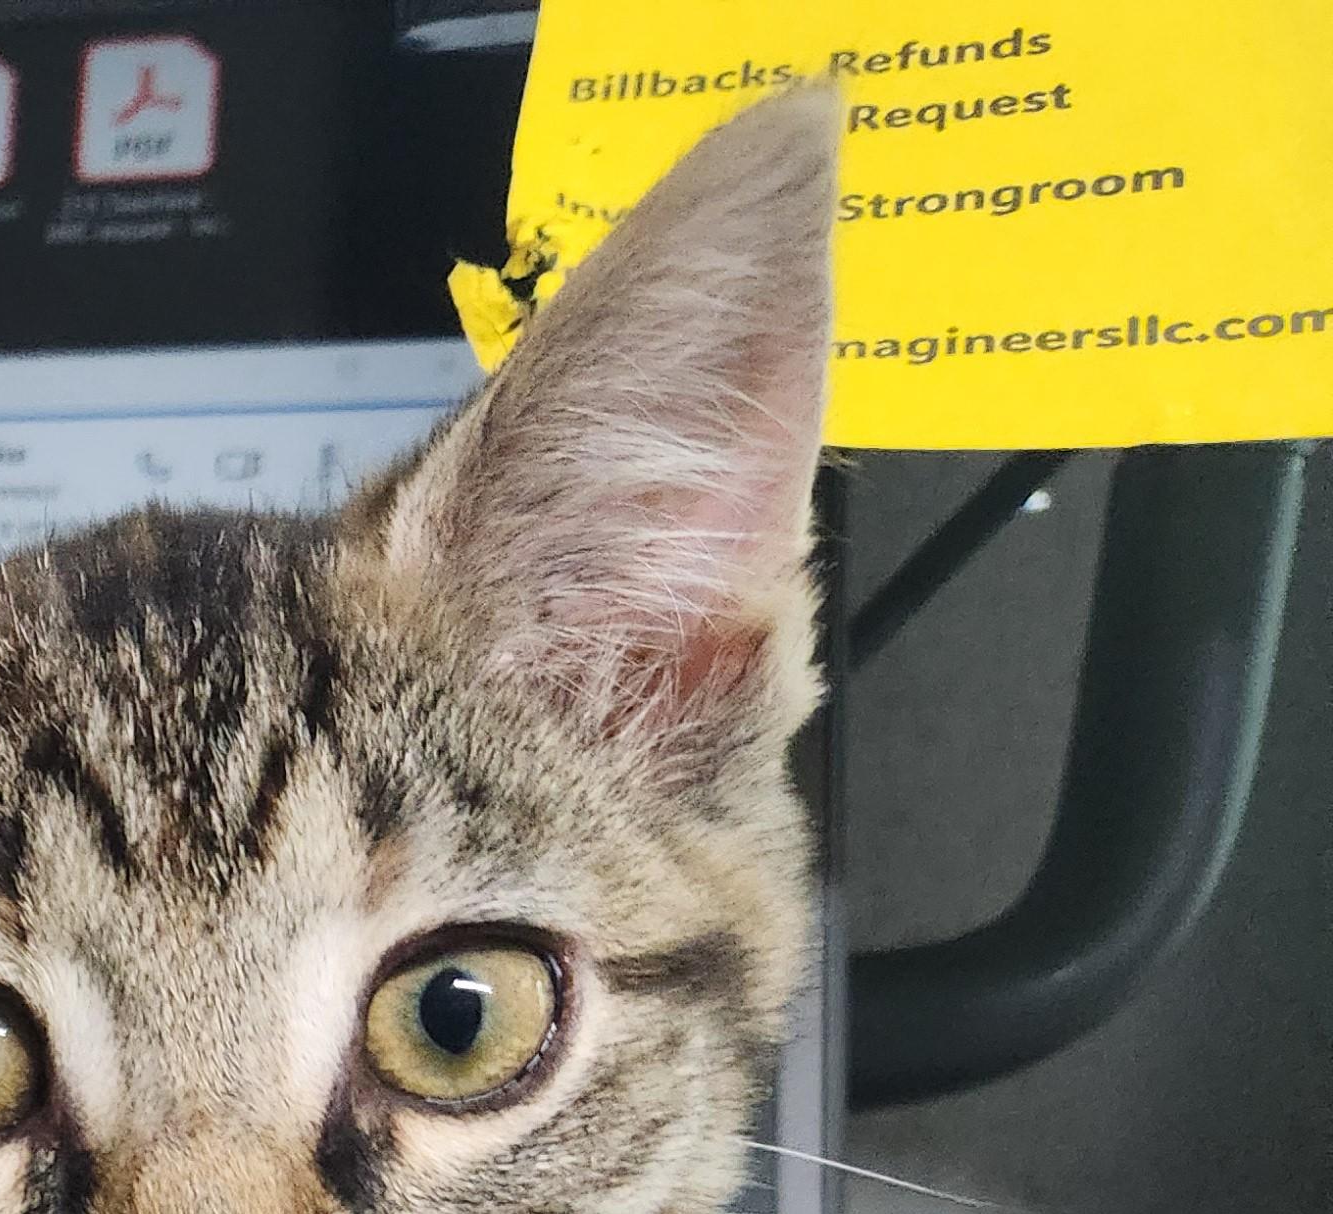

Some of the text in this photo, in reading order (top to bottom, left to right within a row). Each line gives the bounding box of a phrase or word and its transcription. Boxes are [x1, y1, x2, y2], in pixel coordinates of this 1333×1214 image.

[830, 27, 1053, 79] Refunds
[846, 83, 1073, 135] Request
[838, 162, 1186, 225] Strongroom
